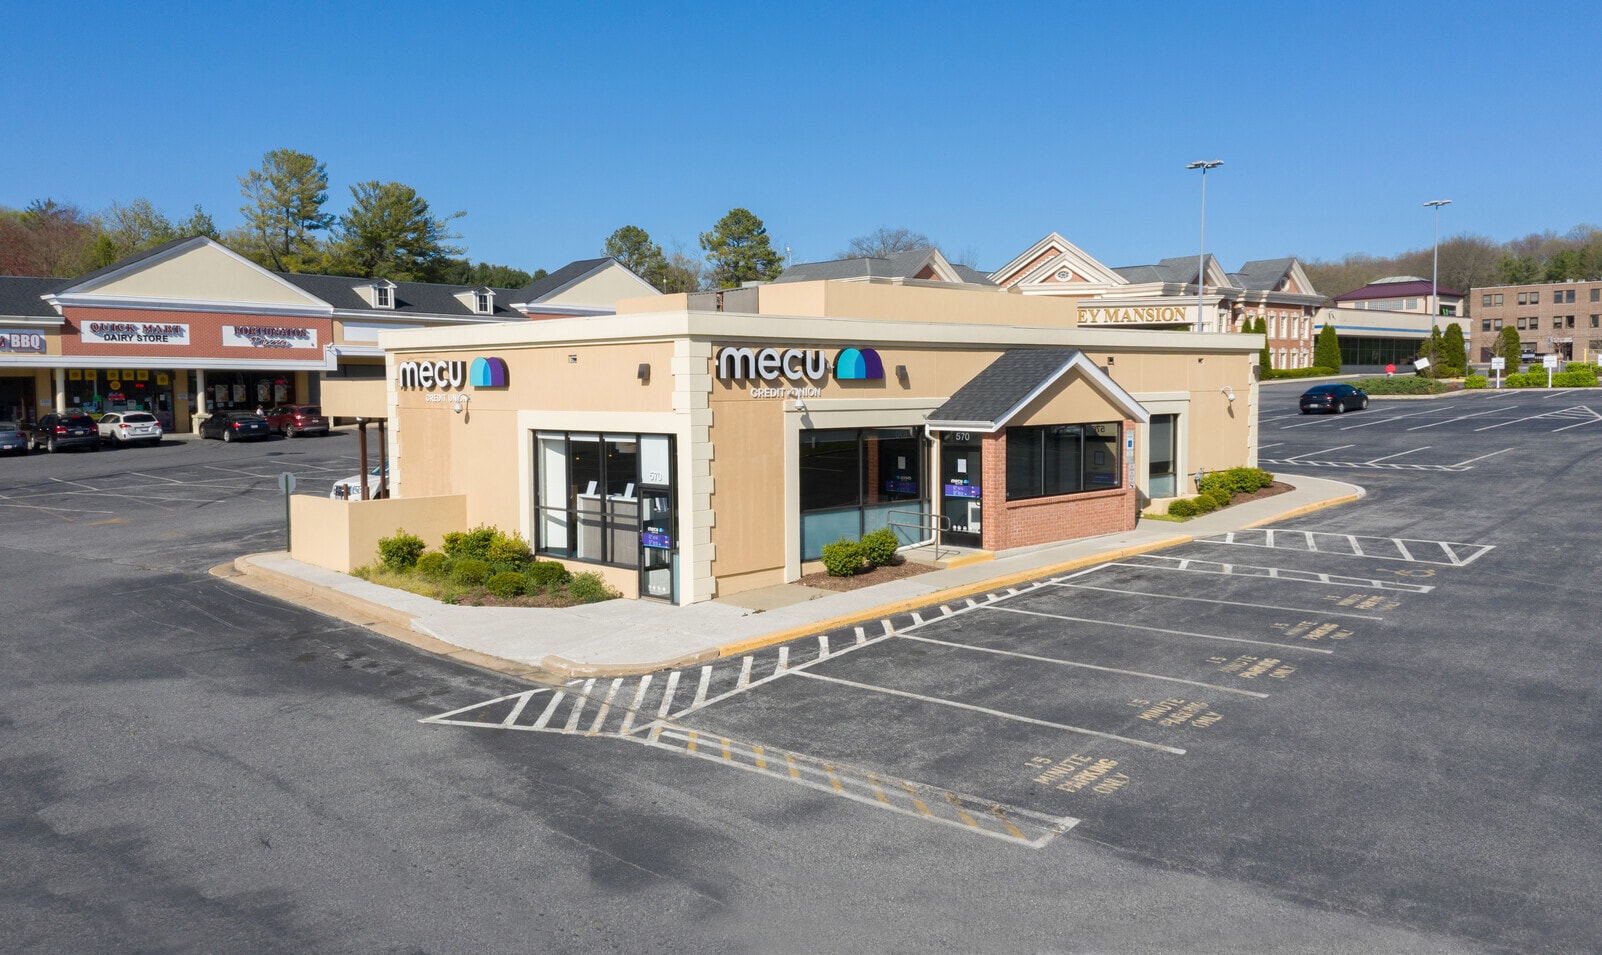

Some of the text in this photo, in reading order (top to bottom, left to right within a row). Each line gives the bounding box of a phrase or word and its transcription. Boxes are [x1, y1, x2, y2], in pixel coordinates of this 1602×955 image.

[1103, 307, 1187, 323] MANSION
[90, 322, 181, 334] QUICK MART
[10, 333, 41, 350] BBQ
[104, 333, 169, 343] DAIRY STORE
[719, 347, 825, 380] mecu
[399, 360, 462, 388] mecu
[750, 387, 785, 398] CREDIT
[956, 432, 970, 441] 570
[1137, 697, 1185, 721] MINUTE
[1191, 711, 1225, 728] ONLY
[1024, 756, 1052, 769] 15
[1032, 753, 1092, 785] MINUTE
[1056, 758, 1119, 793] PARKING
[1092, 772, 1130, 794] ONLY
